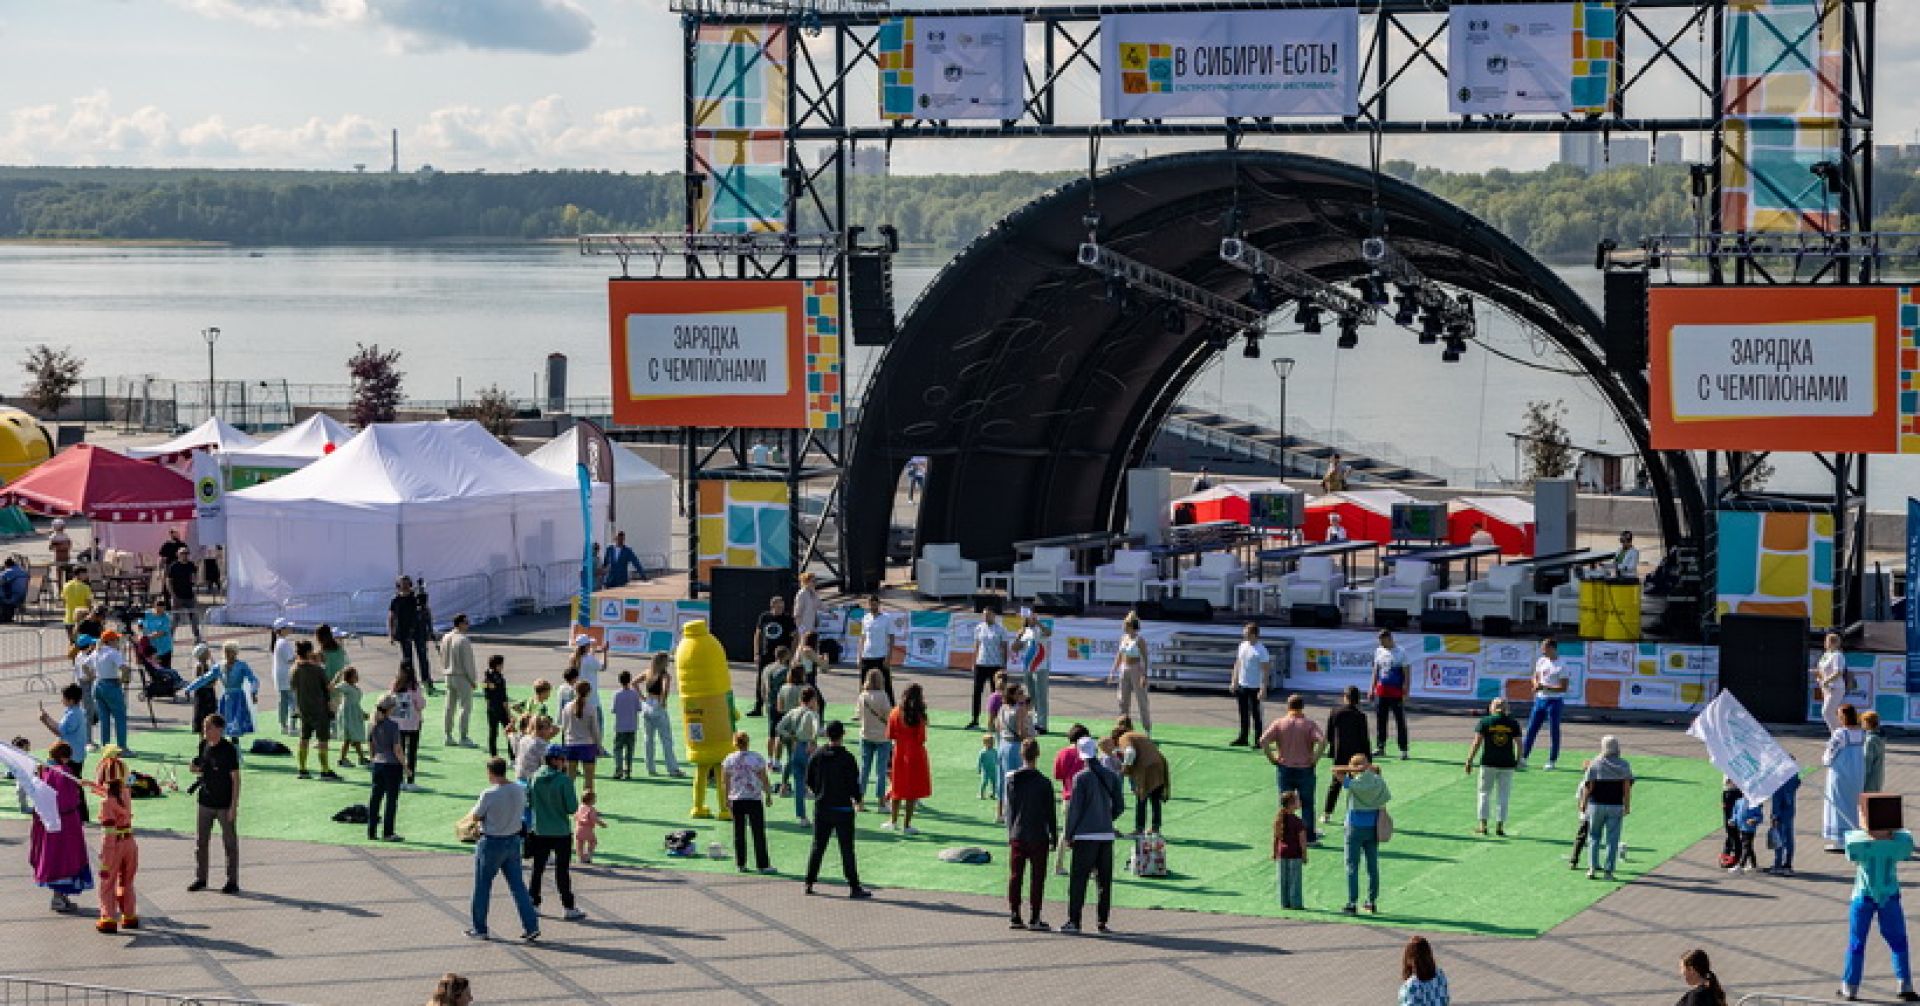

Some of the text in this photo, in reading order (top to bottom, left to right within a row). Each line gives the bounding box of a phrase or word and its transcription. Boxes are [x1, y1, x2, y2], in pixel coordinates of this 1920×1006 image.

[1174, 42, 1338, 77] В СИБИРИ-ЕСТЬ!
[673, 324, 740, 356] ЗАРЯДКА
[1730, 338, 1813, 372] ЗАРЯДКА
[648, 357, 767, 382] С ЧЕМПИОНАМИ
[1697, 373, 1848, 402] С ЧЕМПИОНАМИ
